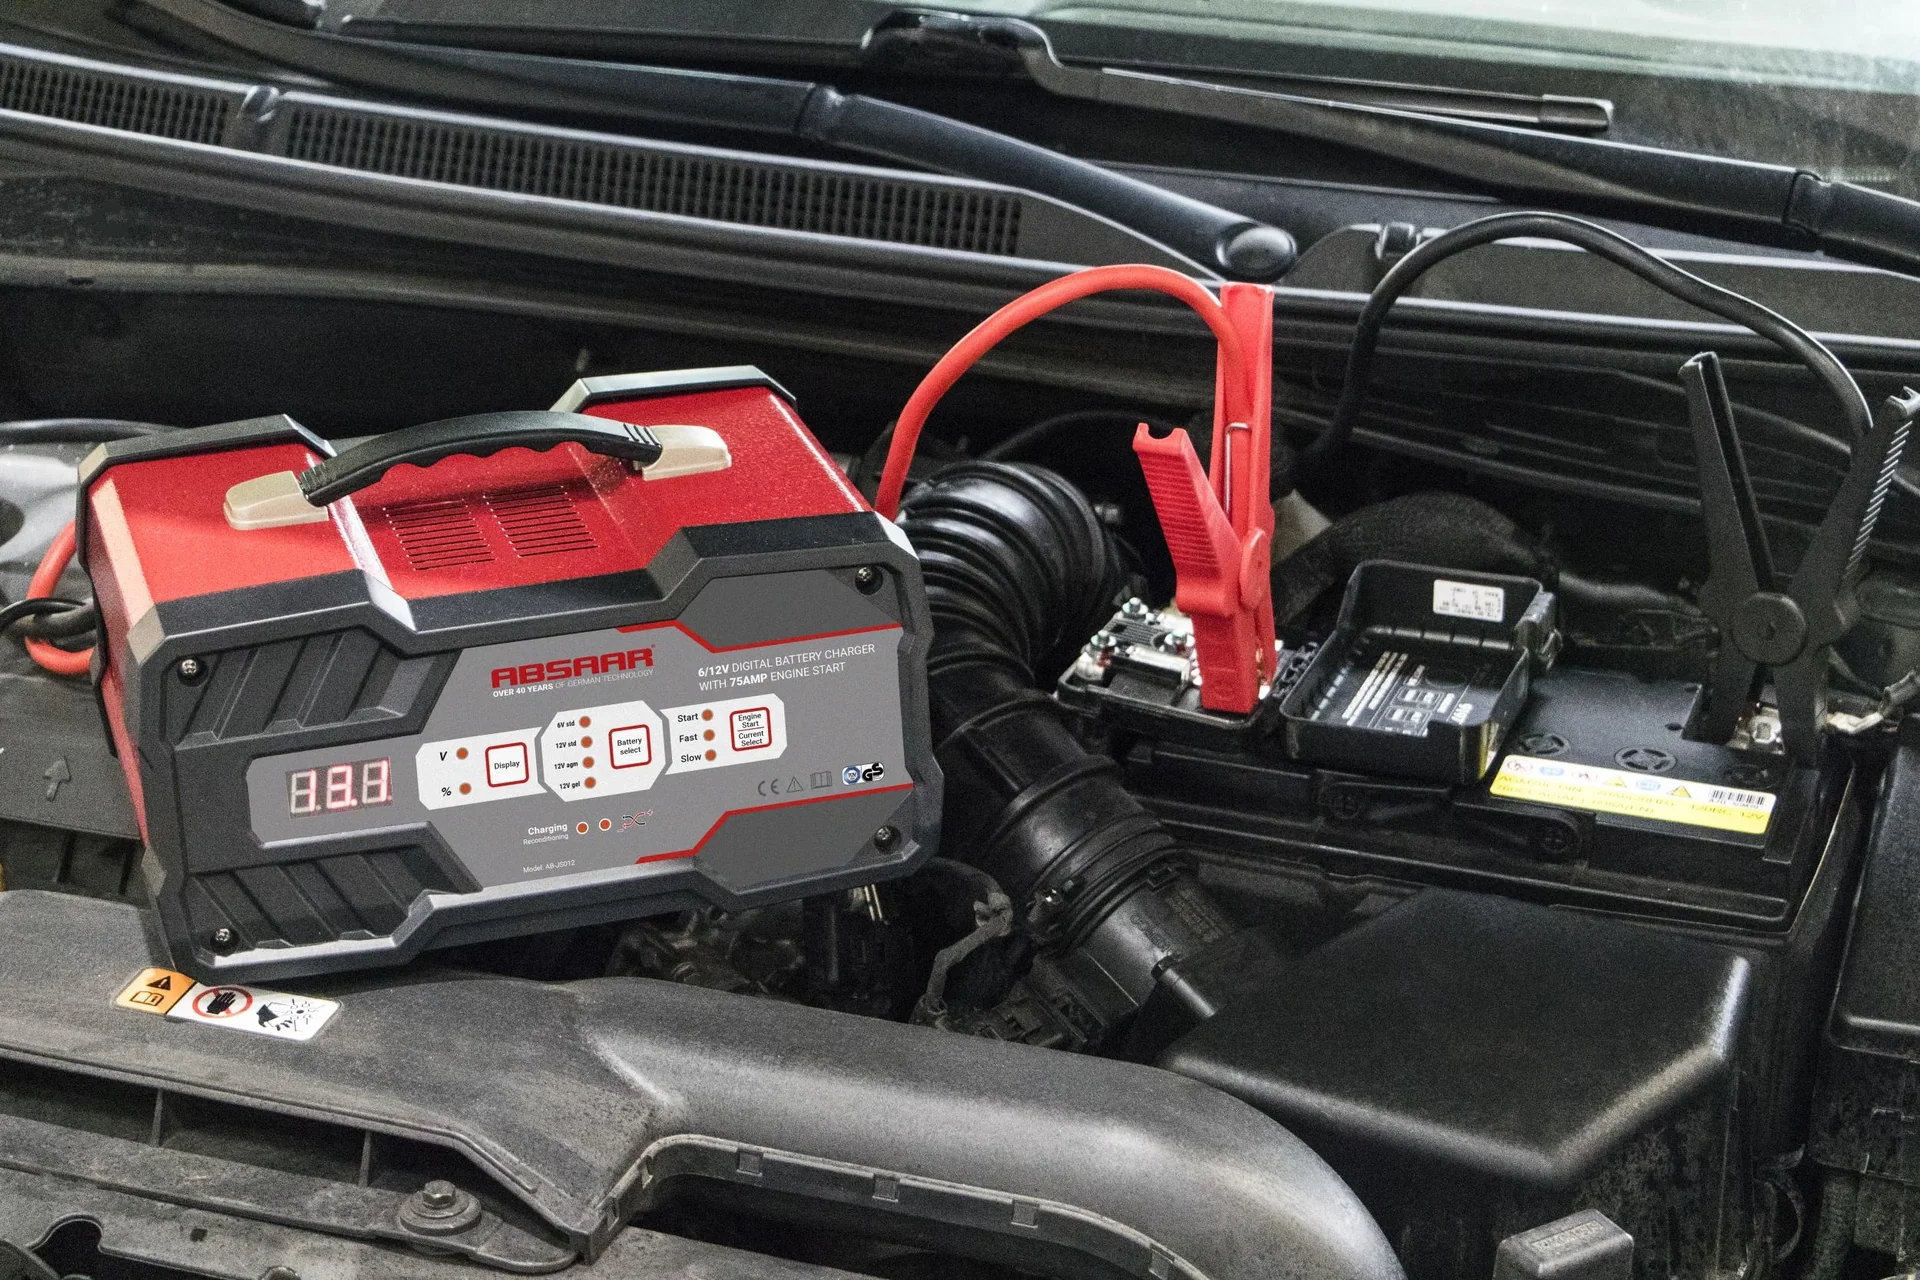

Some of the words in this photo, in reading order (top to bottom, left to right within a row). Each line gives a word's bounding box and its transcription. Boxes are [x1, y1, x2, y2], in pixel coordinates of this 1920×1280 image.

[698, 664, 730, 677] 6/12V
[732, 659, 773, 672] DIGITAL
[775, 651, 822, 666] BATTERY
[824, 644, 876, 660] CHARGER
[699, 679, 727, 692] WITH
[730, 673, 768, 687] 75AMP
[770, 667, 810, 682] ENGINE
[812, 662, 846, 675] START
[493, 688, 514, 698] OVER
[516, 686, 526, 694] 40
[527, 683, 554, 693] YEARS
[555, 681, 565, 689] OF
[567, 676, 600, 688] GERMAN
[604, 668, 654, 682] TECHNOLOGY
[677, 712, 698, 723] Start
[738, 713, 761, 722] Engine
[742, 720, 759, 729] Start
[679, 733, 698, 743] Fast
[738, 730, 764, 740] Current
[617, 737, 642, 747] Battery
[741, 738, 763, 747] Select
[439, 751, 448, 761] V
[620, 747, 641, 755] select
[680, 754, 702, 763] Slow
[494, 760, 520, 770] Display
[566, 761, 578, 769] agm
[862, 762, 884, 781] GS
[571, 780, 581, 789] gel
[441, 786, 452, 796] %
[528, 824, 568, 836] Charging
[523, 833, 569, 845] Reconditioning
[522, 866, 543, 874] Model:
[545, 860, 576, 870] AB-JS012
